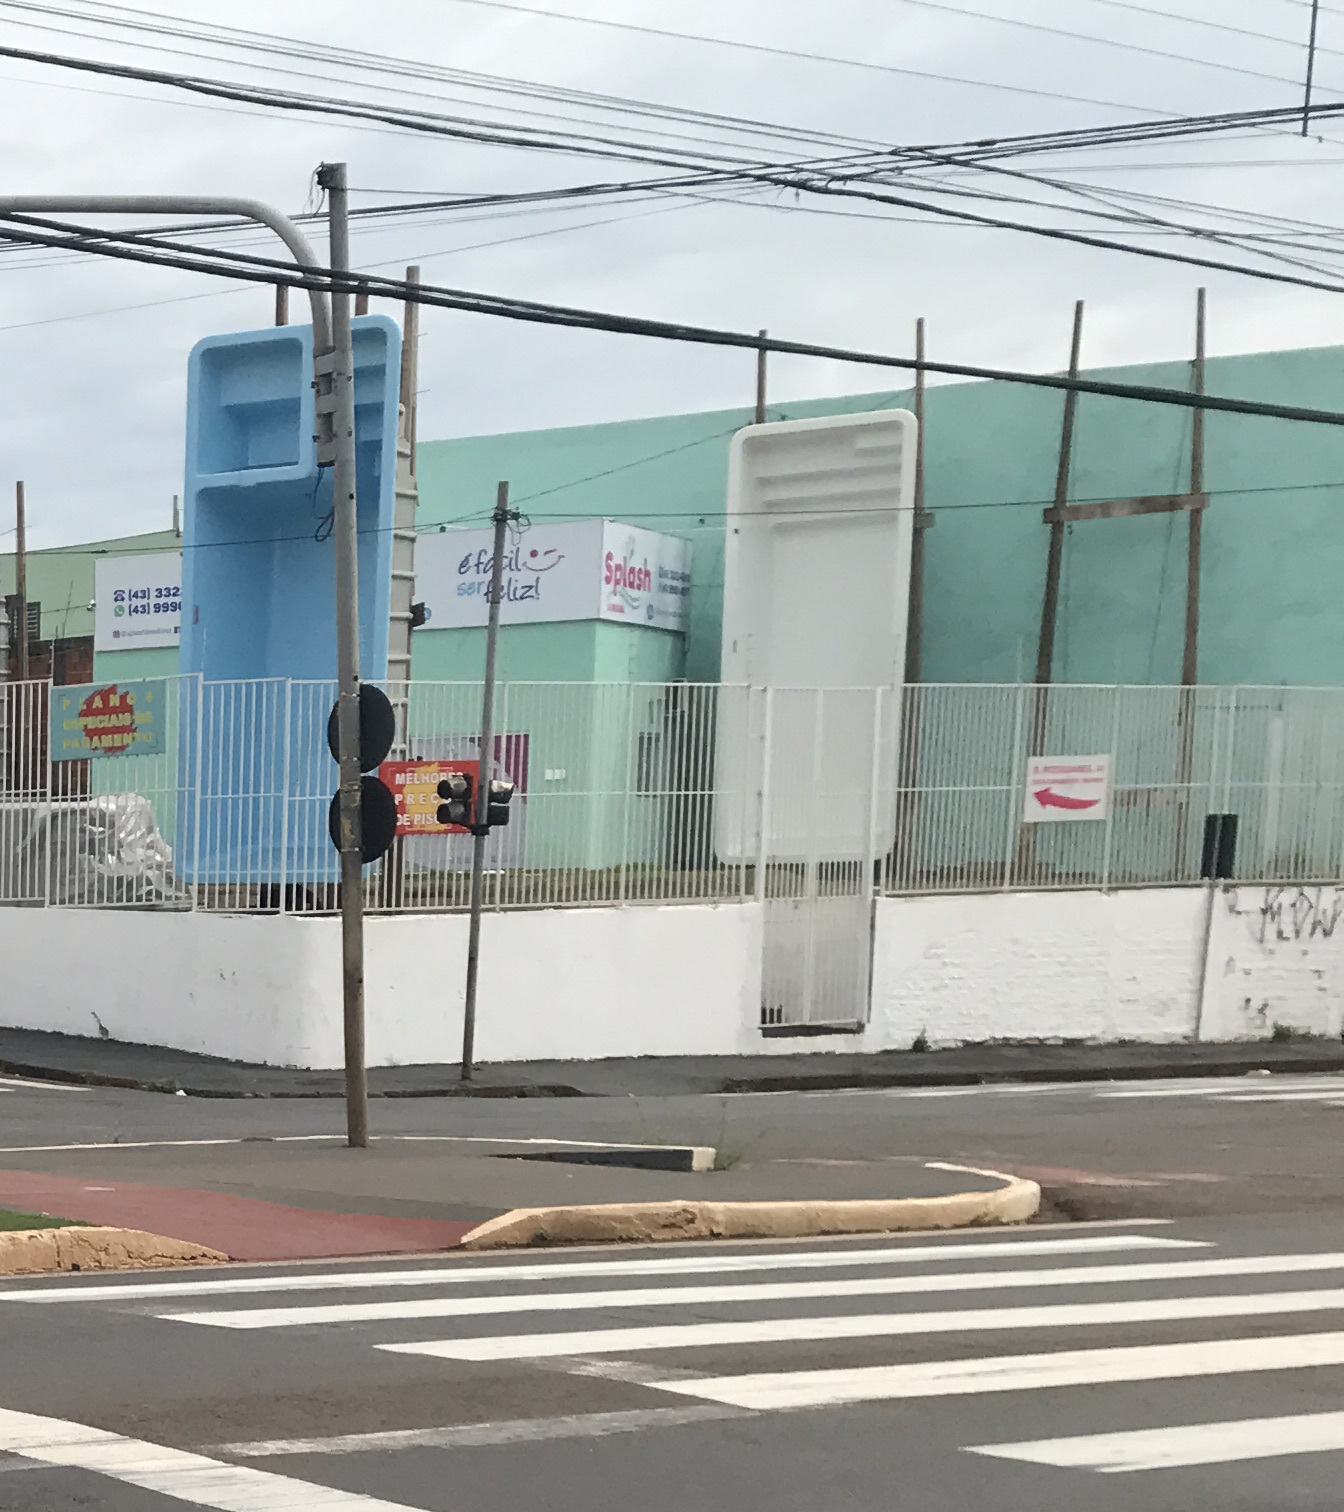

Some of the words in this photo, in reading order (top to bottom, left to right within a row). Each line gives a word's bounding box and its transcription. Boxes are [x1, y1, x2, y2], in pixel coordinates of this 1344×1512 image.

[604, 551, 653, 597] Splash
[128, 587, 151, 602] (43)
[457, 581, 485, 597] ser
[128, 602, 151, 616] (43)
[63, 731, 153, 751] PAGAMENTO
